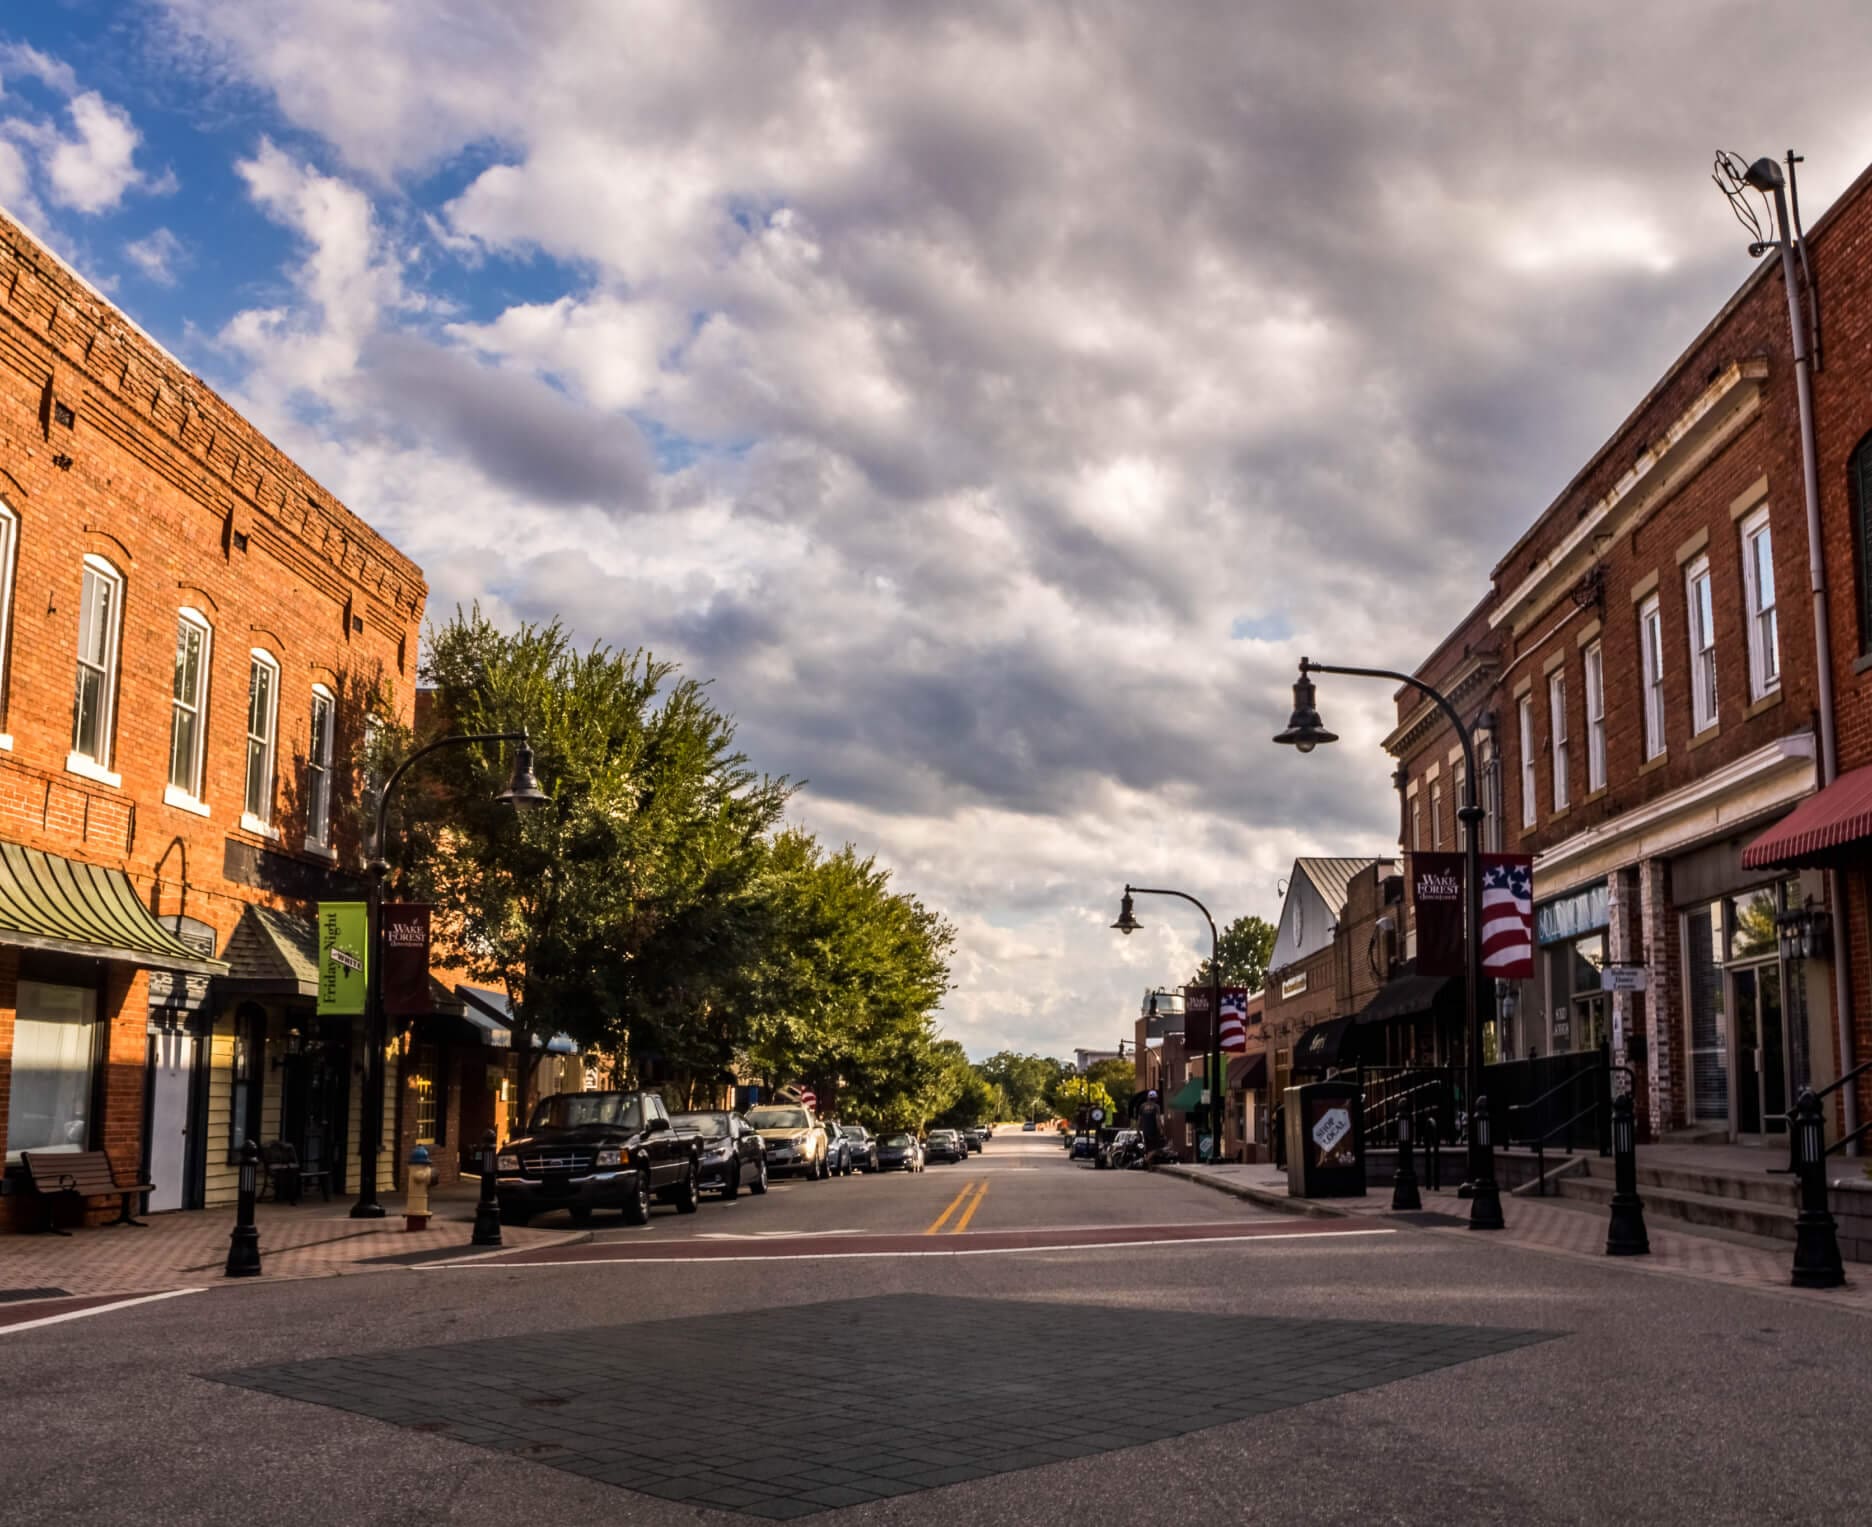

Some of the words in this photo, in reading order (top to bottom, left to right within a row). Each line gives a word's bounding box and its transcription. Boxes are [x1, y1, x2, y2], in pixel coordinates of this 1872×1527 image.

[1417, 882, 1459, 895] FOREST
[1422, 874, 1456, 885] WAKE
[323, 912, 341, 951] Night
[388, 930, 426, 942] FOREST
[393, 923, 424, 933] WAKE
[336, 952, 362, 970] WHITE
[323, 960, 341, 1004] Friday
[1315, 1117, 1335, 1138] SHOP
[1322, 1120, 1346, 1146] LOCAL
